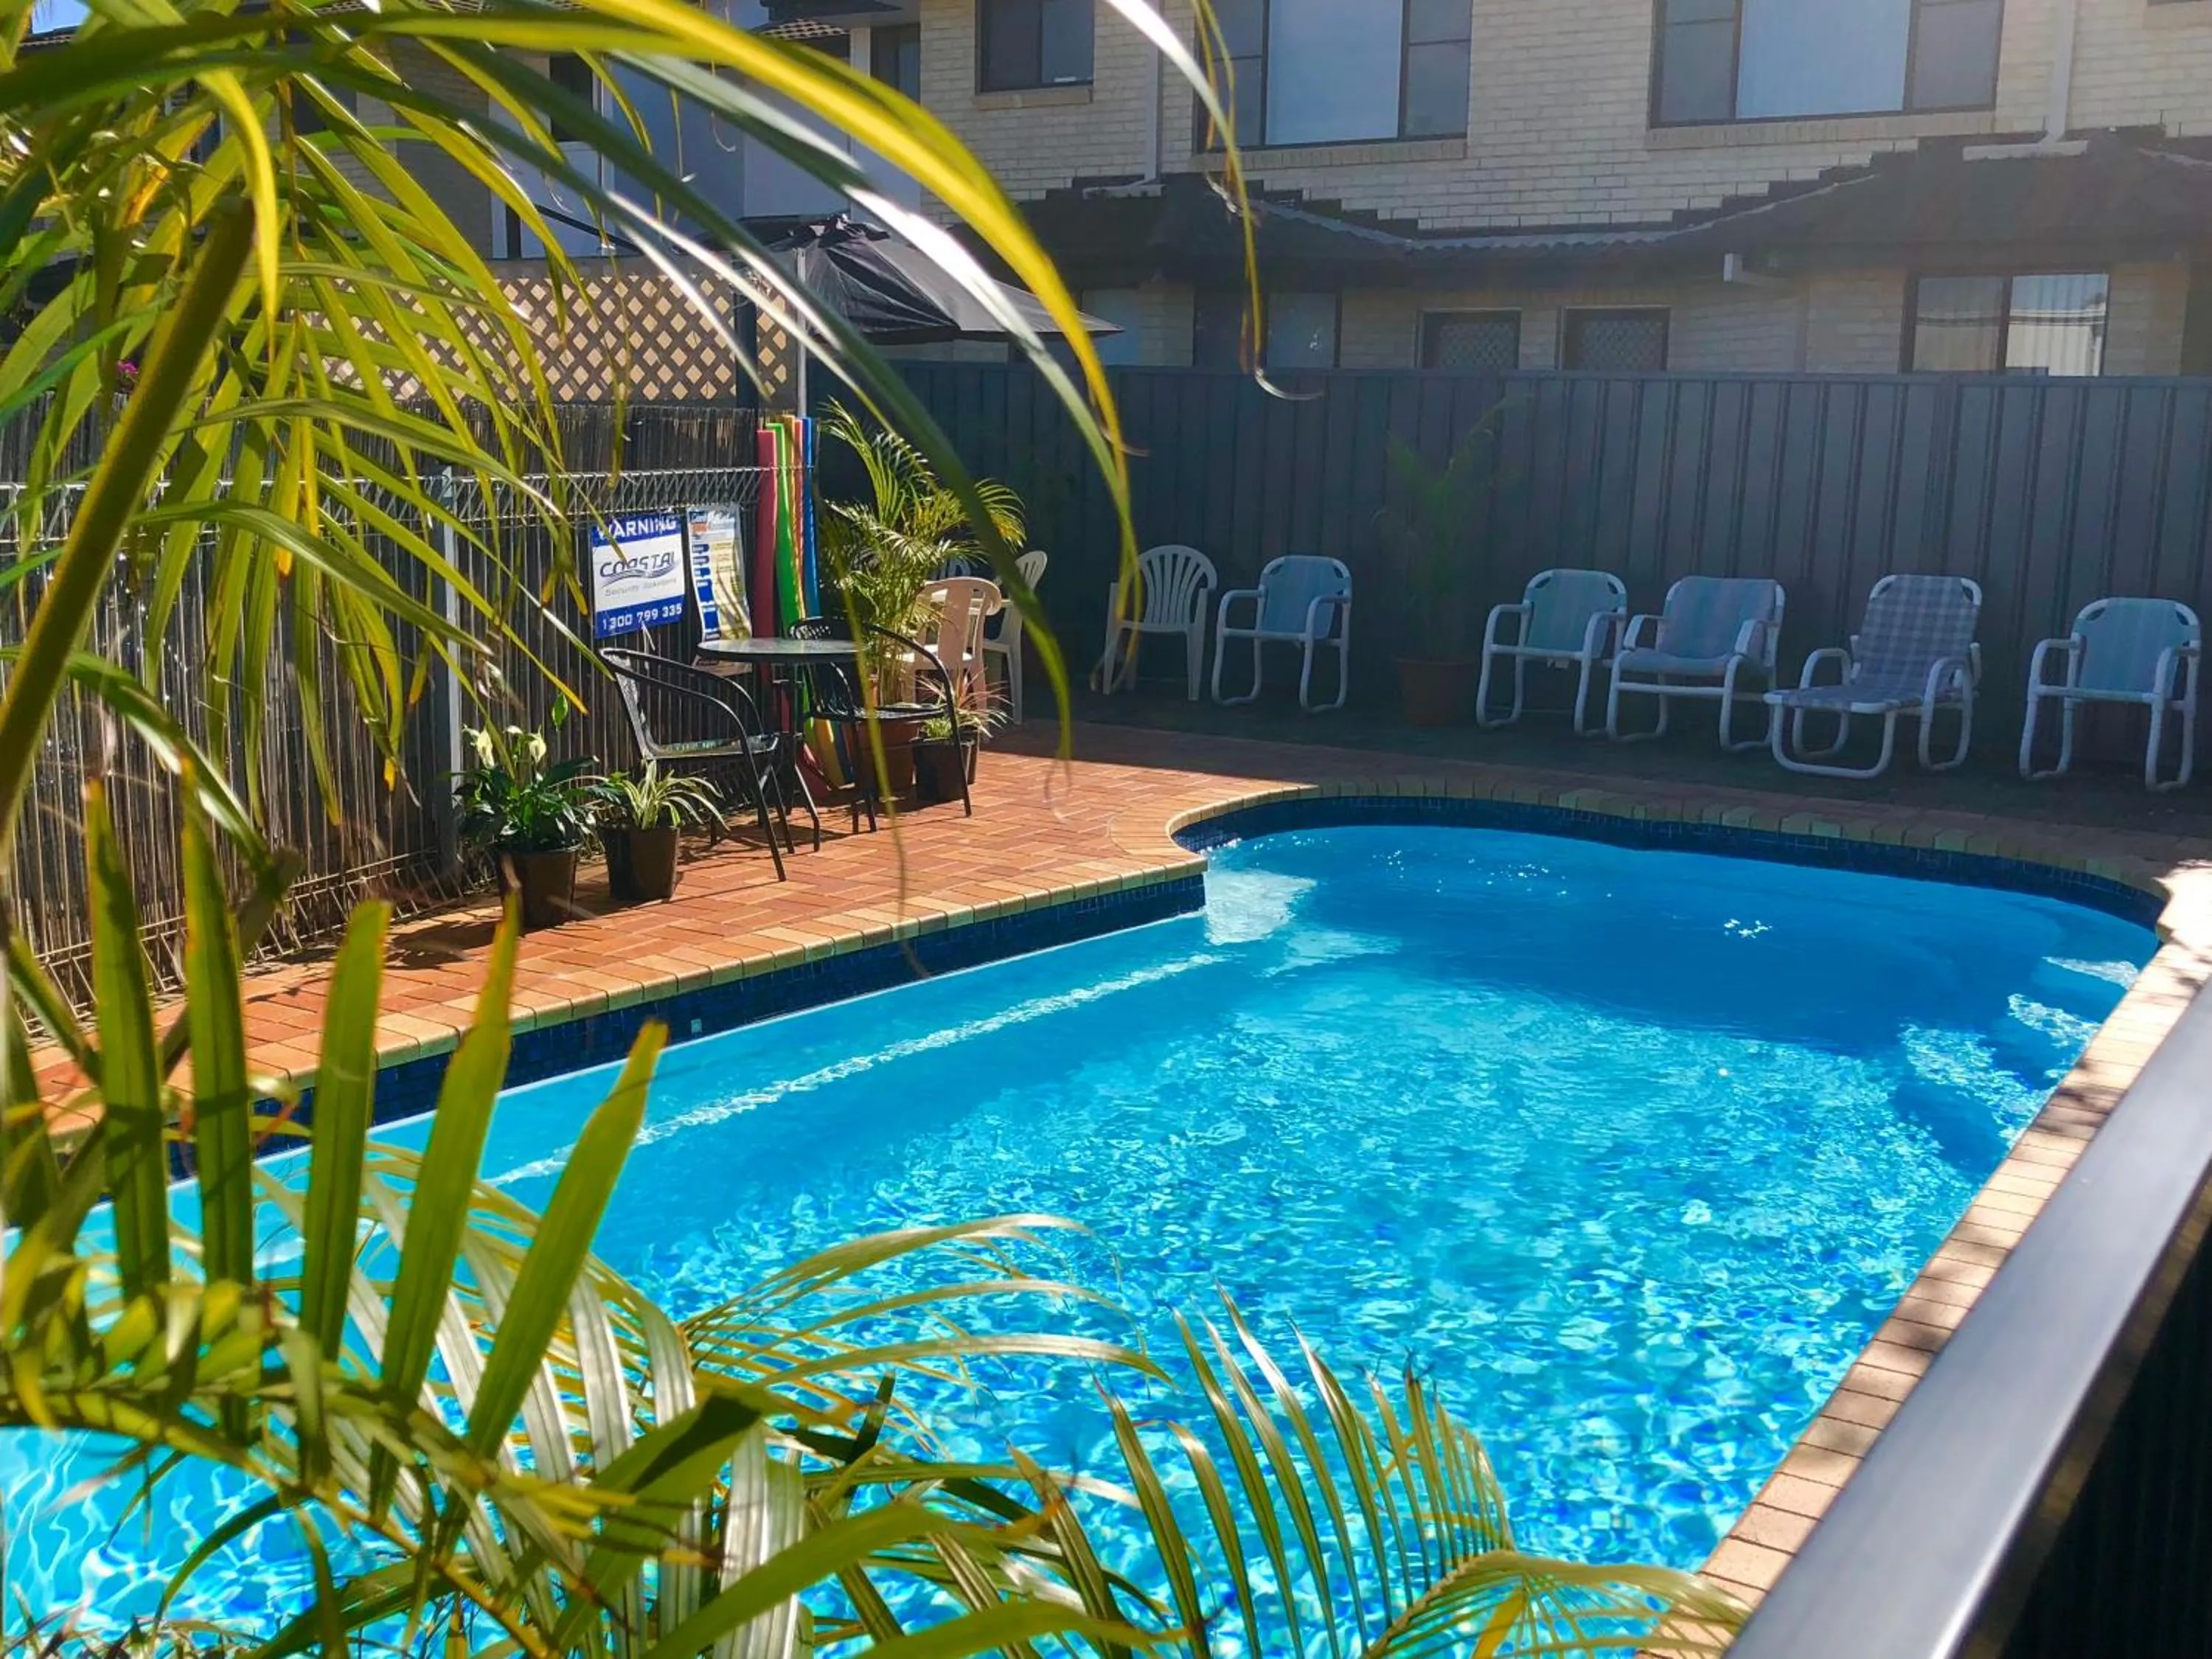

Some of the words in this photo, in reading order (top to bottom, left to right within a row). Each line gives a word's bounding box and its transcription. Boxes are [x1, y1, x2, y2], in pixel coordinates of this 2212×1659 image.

[602, 613, 633, 630] 1300
[636, 608, 658, 624] 799
[662, 602, 683, 618] 335
